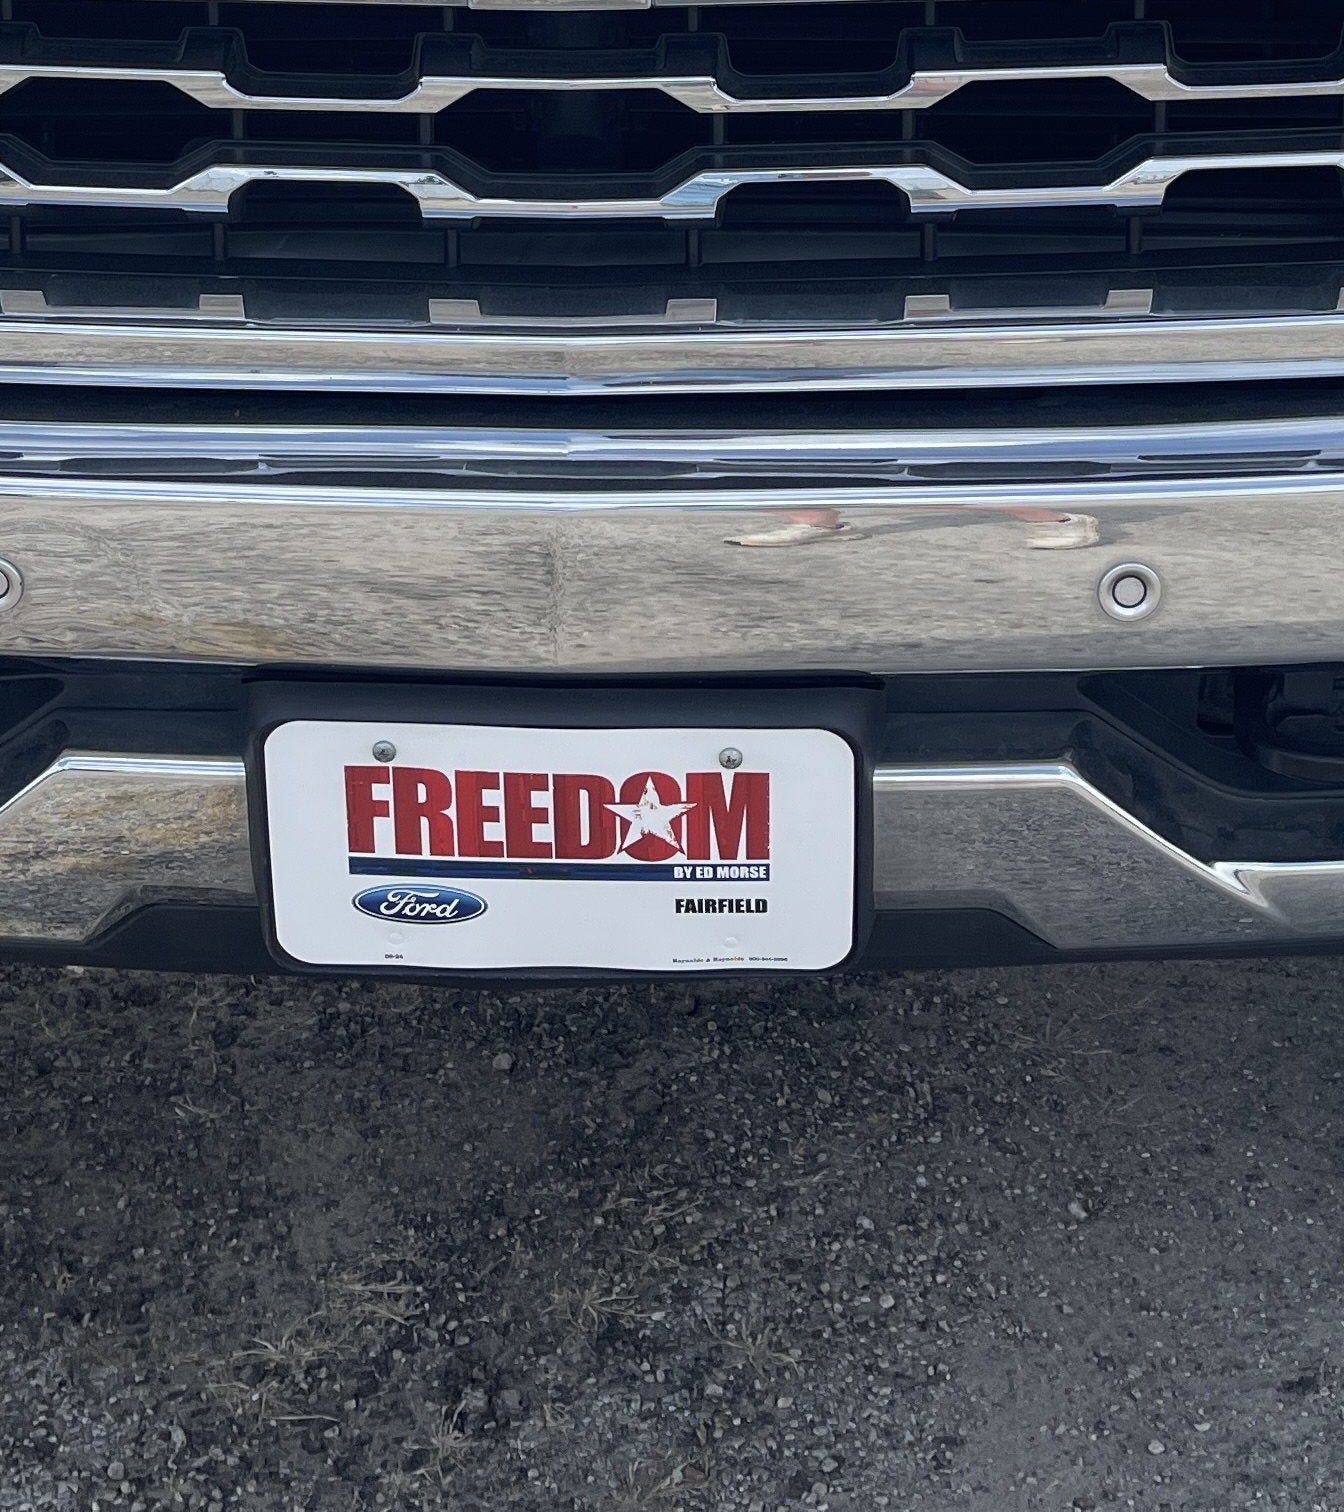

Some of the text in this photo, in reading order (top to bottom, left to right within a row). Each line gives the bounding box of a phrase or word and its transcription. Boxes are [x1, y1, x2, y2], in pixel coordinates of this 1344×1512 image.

[344, 765, 770, 862] FREEDOM
[673, 866, 767, 879] BY ED MORSE
[379, 889, 460, 918] Ford
[675, 898, 768, 914] FAIRFIELD
